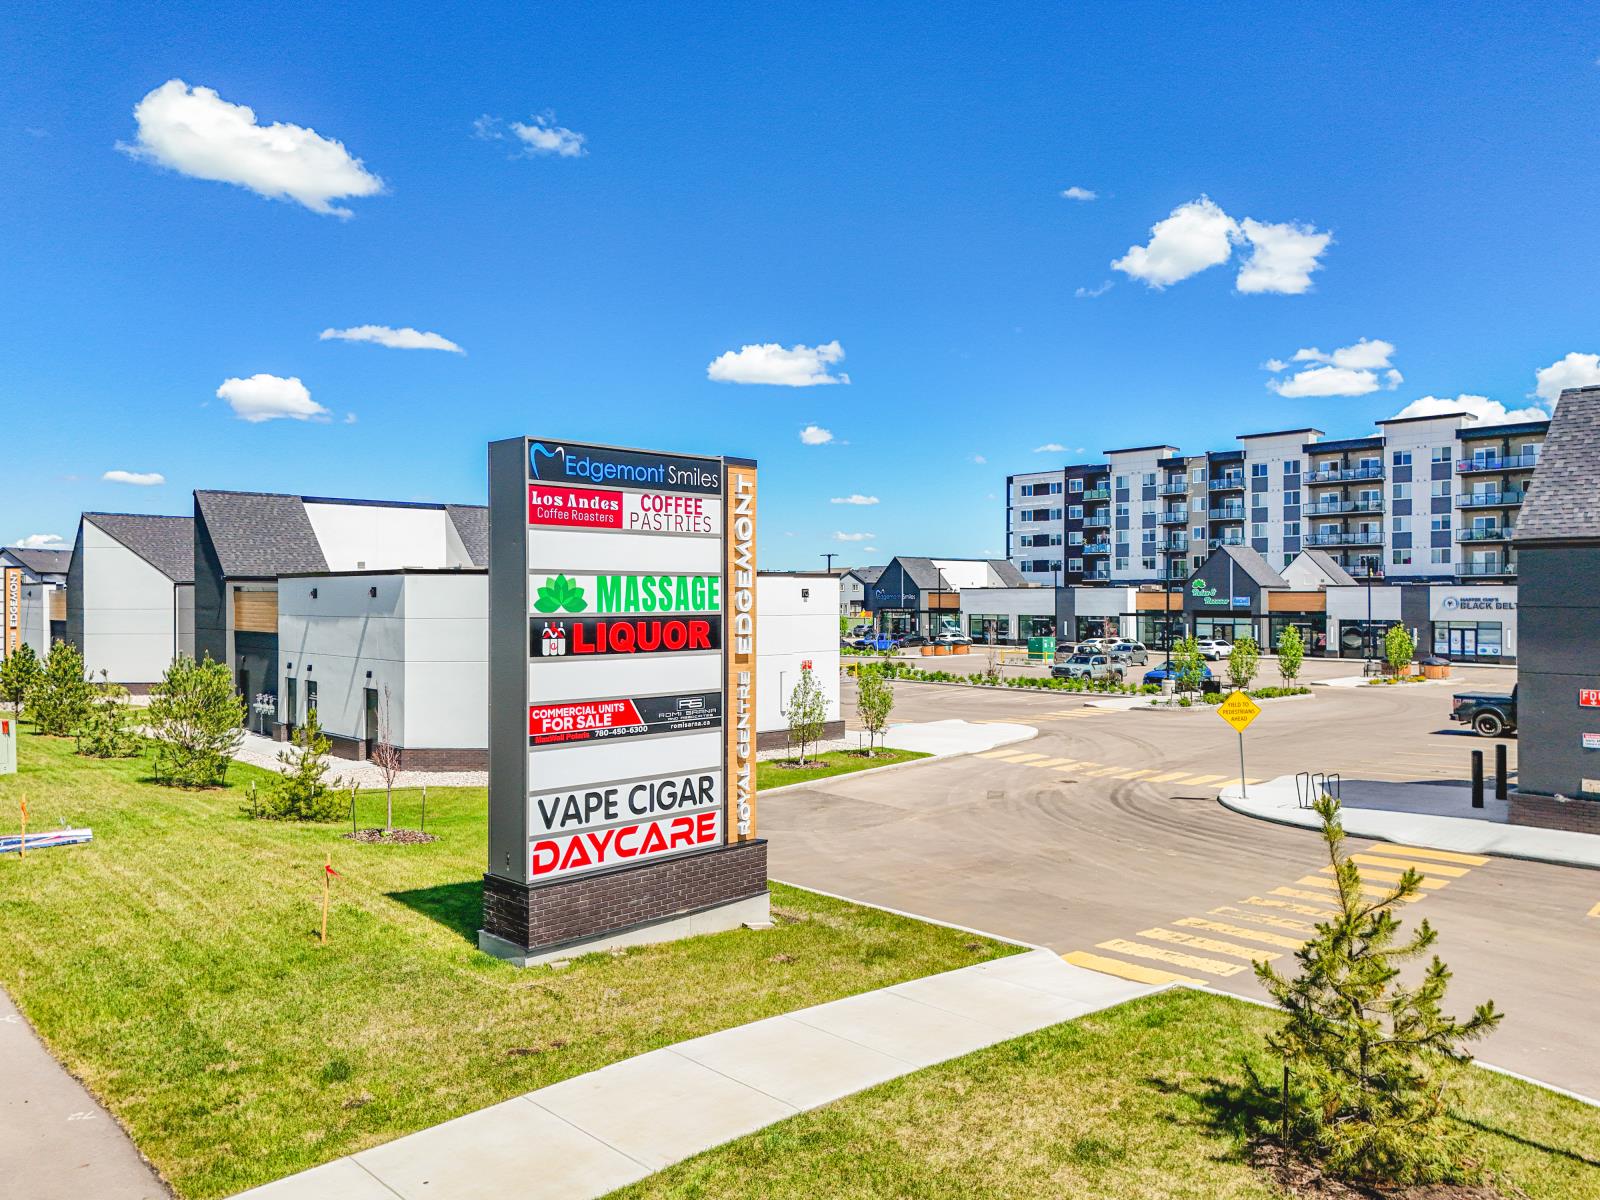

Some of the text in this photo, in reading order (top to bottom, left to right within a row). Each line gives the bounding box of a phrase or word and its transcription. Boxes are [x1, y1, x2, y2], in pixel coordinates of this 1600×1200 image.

[565, 455, 718, 488] Edgemont Smiles
[532, 491, 619, 510] Los Andes
[641, 494, 703, 515] COFFEE
[537, 507, 614, 523] Coffee Roasters
[630, 512, 711, 533] PASTRIES
[735, 474, 752, 655] EDGEMONT
[597, 576, 720, 613] MASSAGE
[1460, 602, 1493, 610] BLACK
[573, 620, 711, 654] LIQUOR
[1582, 690, 1600, 701] FD
[532, 702, 625, 720] COMMERCIAL UNITS
[542, 713, 612, 732] FOR SALE
[594, 725, 648, 738] 780-450-6300
[737, 671, 751, 836] ROYAL CENTRE
[537, 775, 714, 830] VAPE CIGAR
[532, 811, 717, 876] DAYCARE
